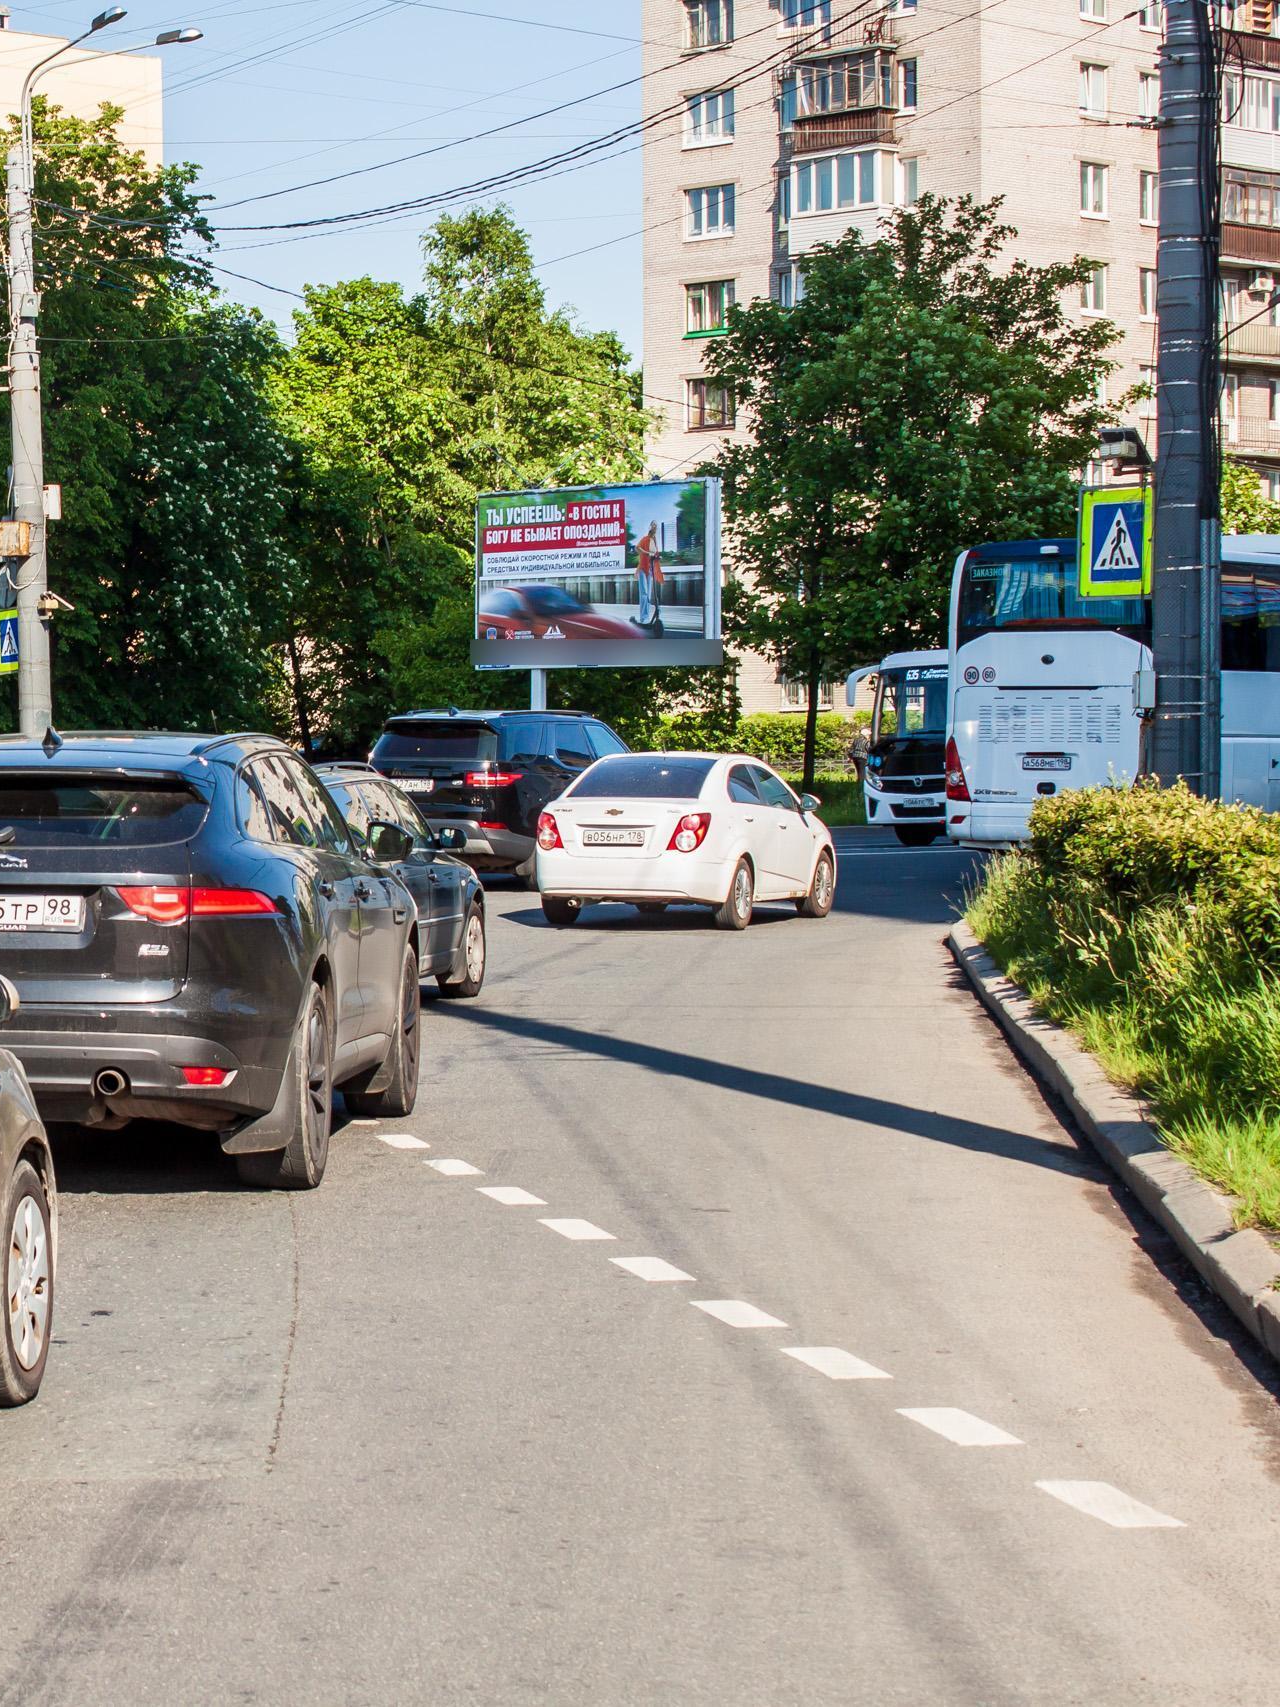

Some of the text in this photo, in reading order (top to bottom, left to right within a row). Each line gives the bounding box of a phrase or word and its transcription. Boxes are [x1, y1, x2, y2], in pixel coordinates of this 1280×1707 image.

[486, 508, 503, 526] ТЫ
[506, 504, 566, 526] УСПЕЕШЬ:
[568, 506, 580, 521] «В
[582, 504, 611, 520] ГОСТИ
[486, 521, 625, 545] БОГУ НЕ БЫВАЕТ ОПОЗДАНИЙ»
[487, 554, 520, 564] СОБЛЮДАЙ
[521, 552, 559, 563] СКОРОСТНОЙ
[560, 552, 582, 560] РЕЖИМ
[588, 551, 601, 559] ПДД
[487, 560, 620, 574] СРЕДСТВАХ ИНДИВИДУАЛЬНОЙ МОБИЛЬНОСТИ
[587, 831, 641, 841] В056НР 178
[47, 899, 70, 915] 98
